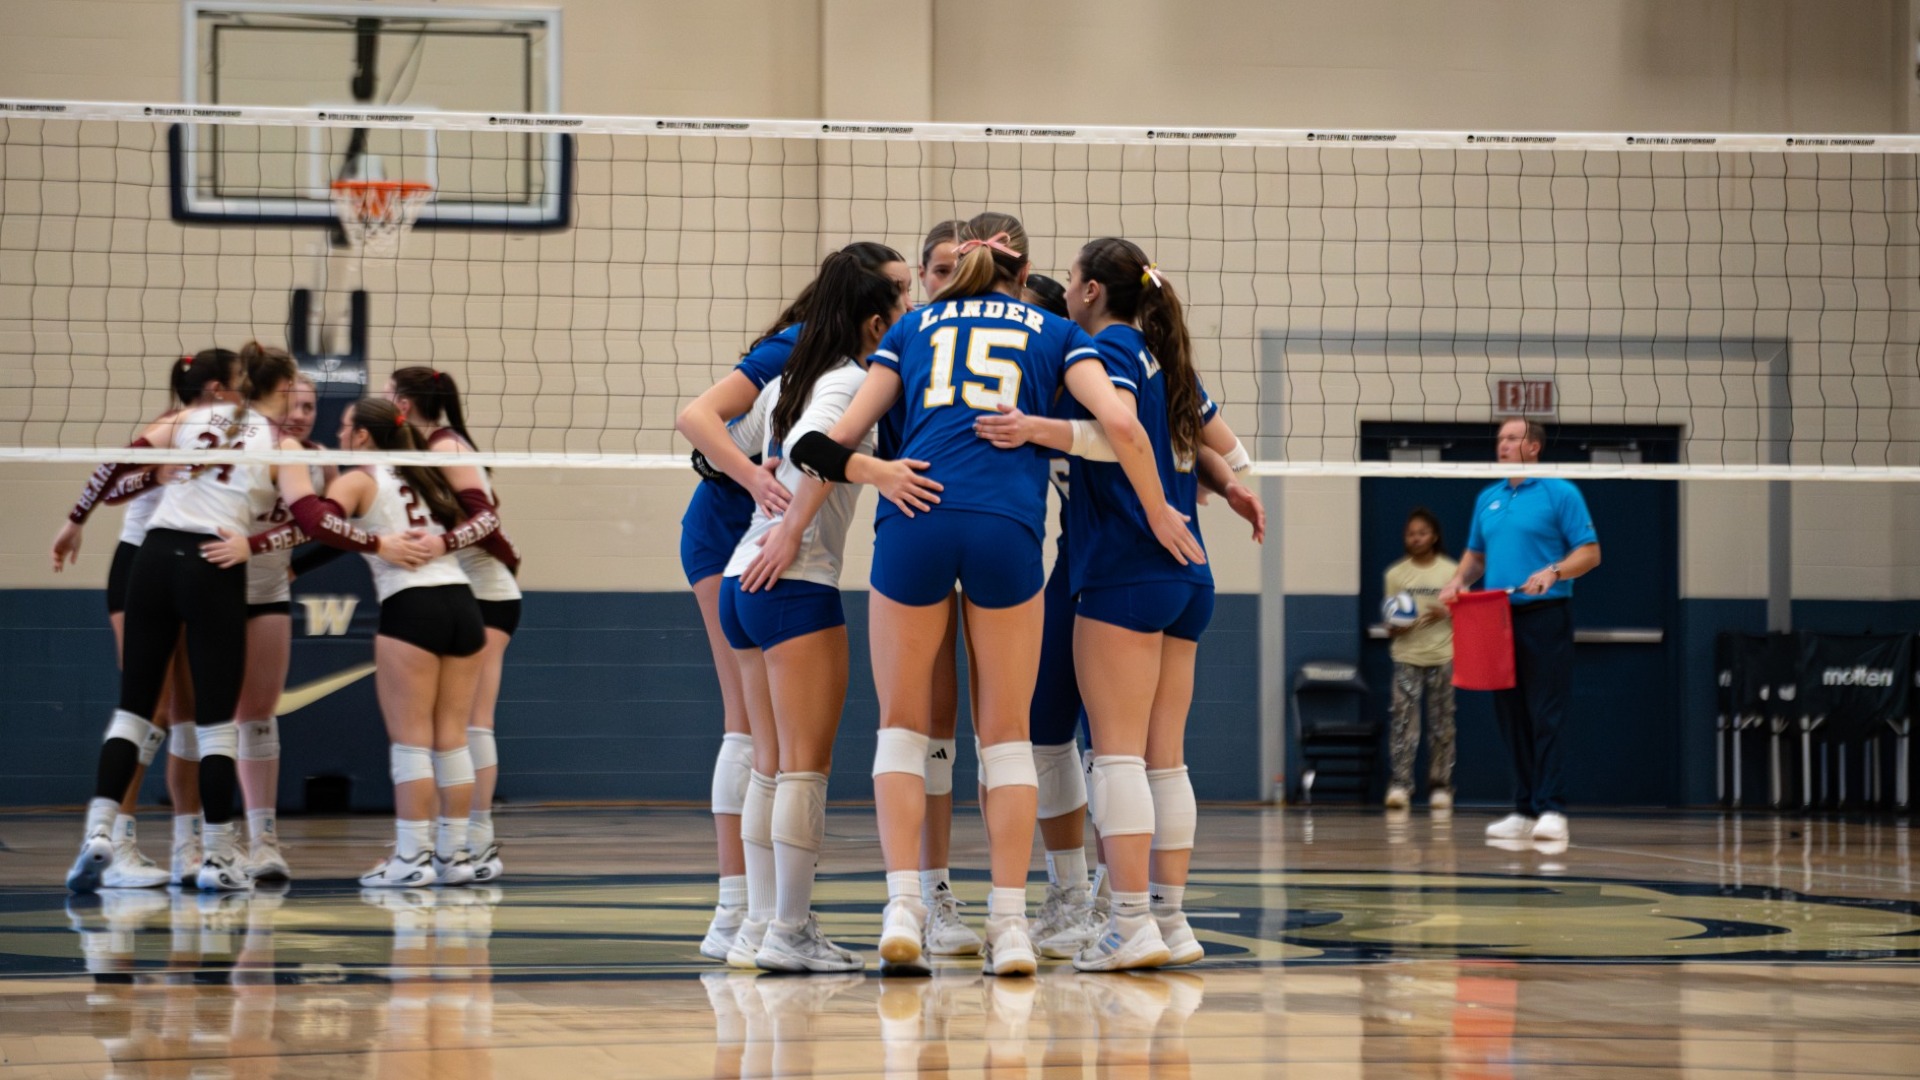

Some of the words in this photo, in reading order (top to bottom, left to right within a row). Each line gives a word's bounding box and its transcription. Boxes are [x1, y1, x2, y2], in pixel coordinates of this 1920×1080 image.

[16, 104, 66, 112] CHAMPIONSHIP
[154, 108, 191, 116] VOLLEYBALL
[328, 113, 364, 121] VOLLEYBALL
[366, 114, 414, 122] CHAMPIONSHIP
[666, 121, 701, 129] VOLLEYBALL
[702, 122, 750, 130] CHAMPIONSHIP
[832, 125, 866, 133] VOLLEYBALL
[868, 126, 913, 134] CHAMPIONSHIP
[1030, 129, 1076, 137] CHAMPIONSHIP
[1156, 131, 1190, 139] VOLLEYBALL
[1636, 137, 1669, 145] VOLLEYBALL
[918, 299, 1044, 334] LANDER
[923, 325, 1029, 414] 15
[1505, 383, 1547, 411] EXIT
[208, 413, 259, 438] BERS
[454, 510, 500, 549] BEARS
[296, 594, 360, 636] W
[1822, 666, 1893, 687] molten
